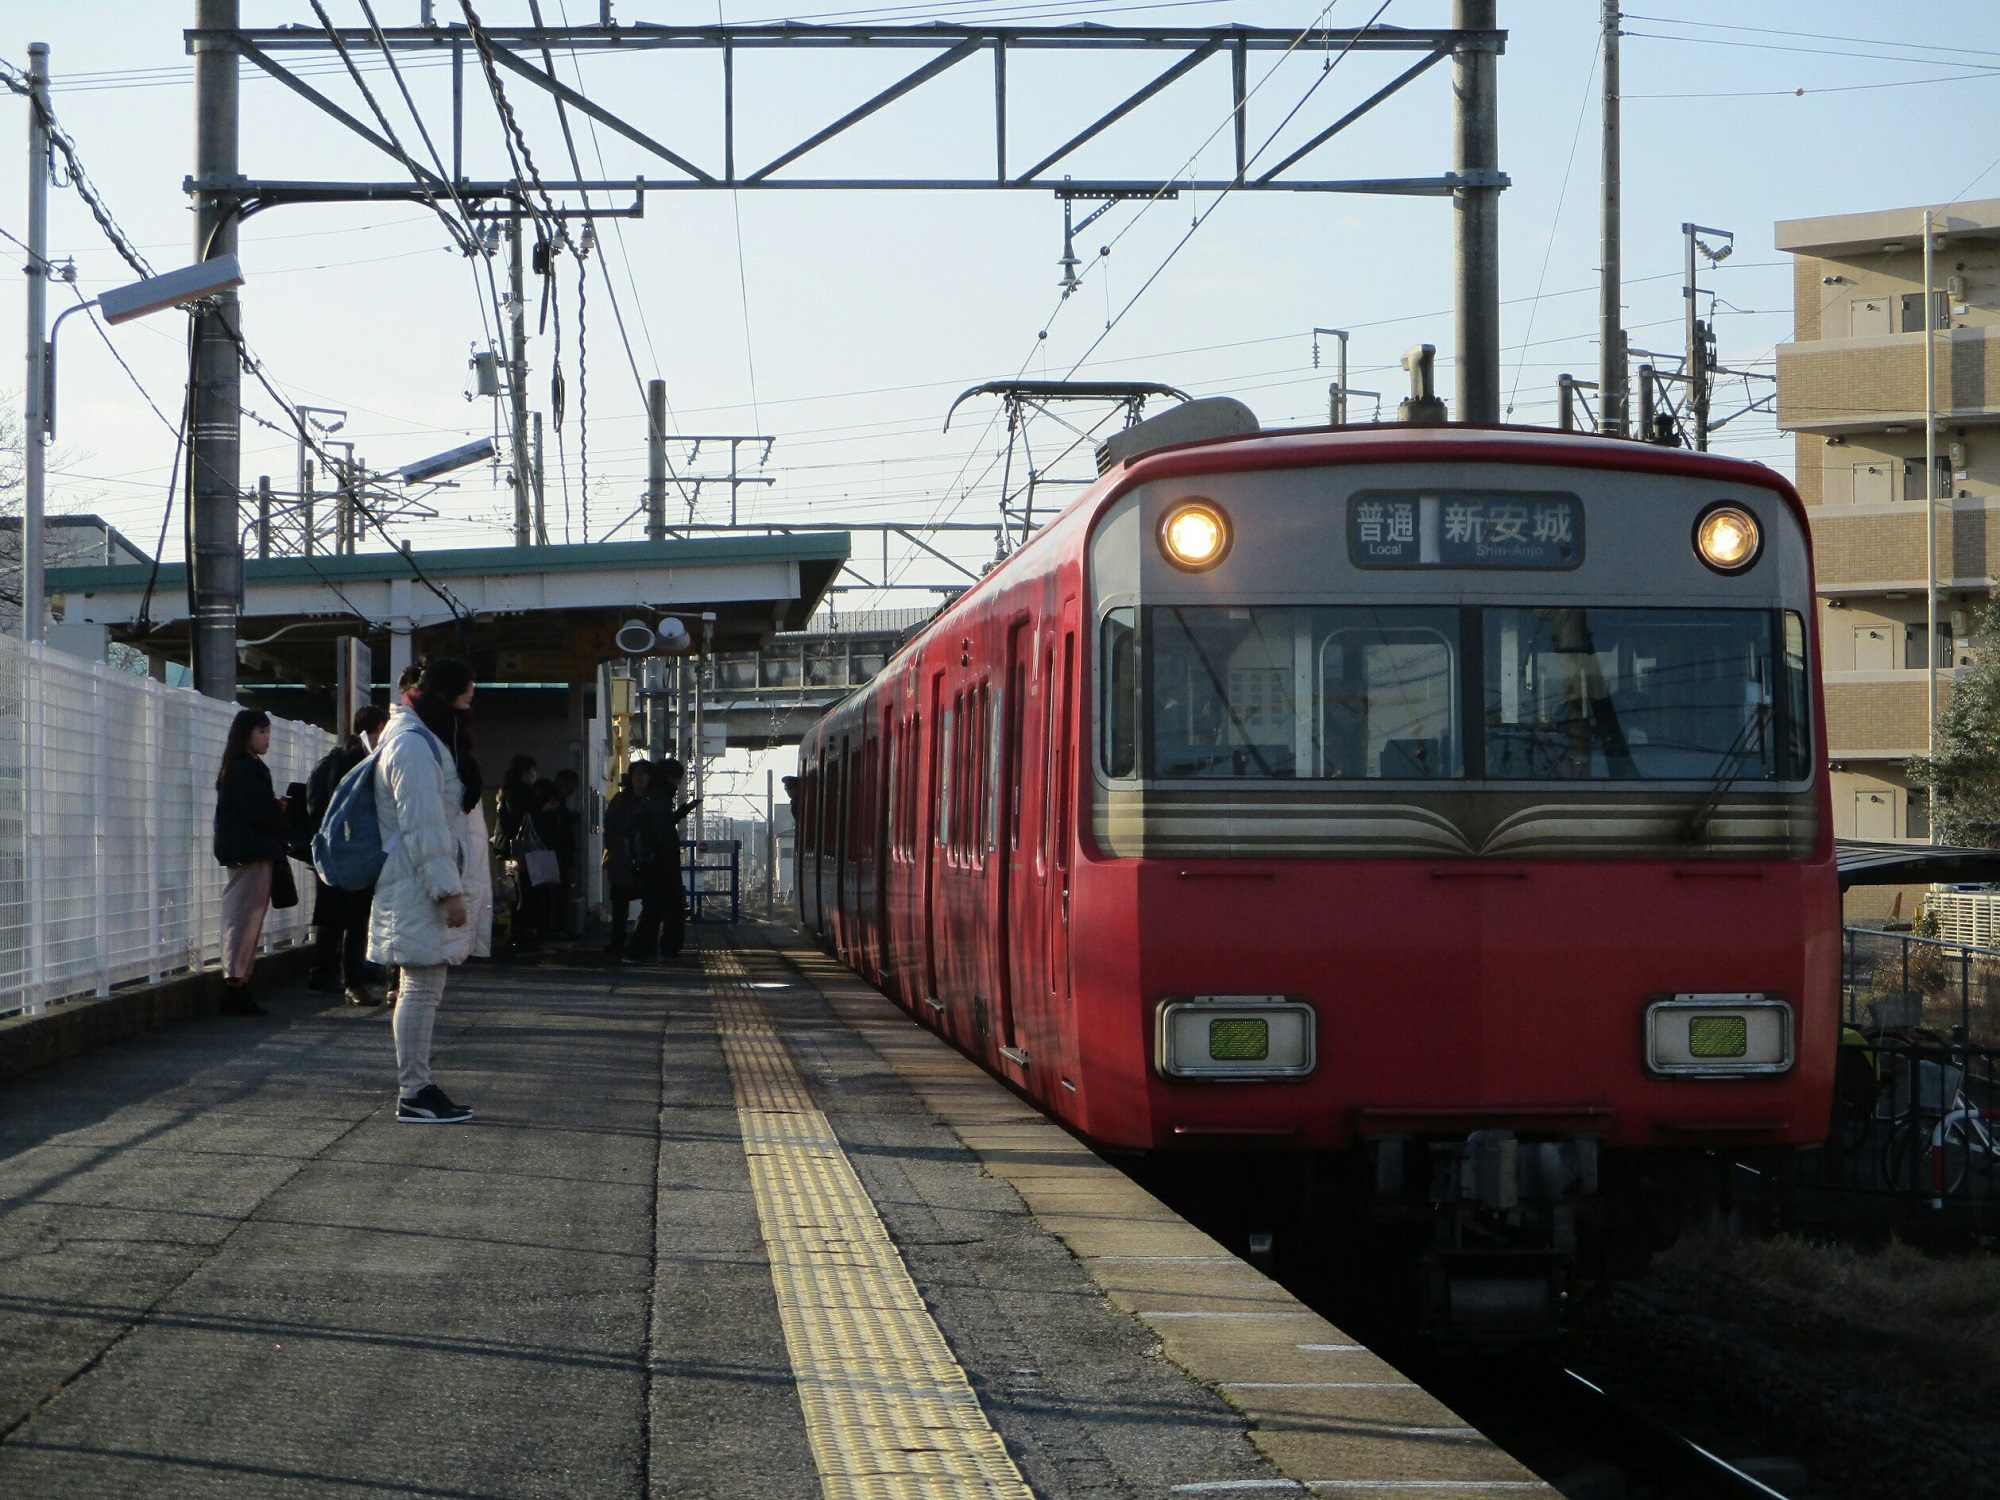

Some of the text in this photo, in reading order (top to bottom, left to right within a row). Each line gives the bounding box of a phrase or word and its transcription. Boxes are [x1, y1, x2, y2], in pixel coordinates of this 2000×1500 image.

[1357, 502, 1414, 543] 普通
[1445, 503, 1572, 543] 新安城
[1369, 543, 1402, 555] Local
